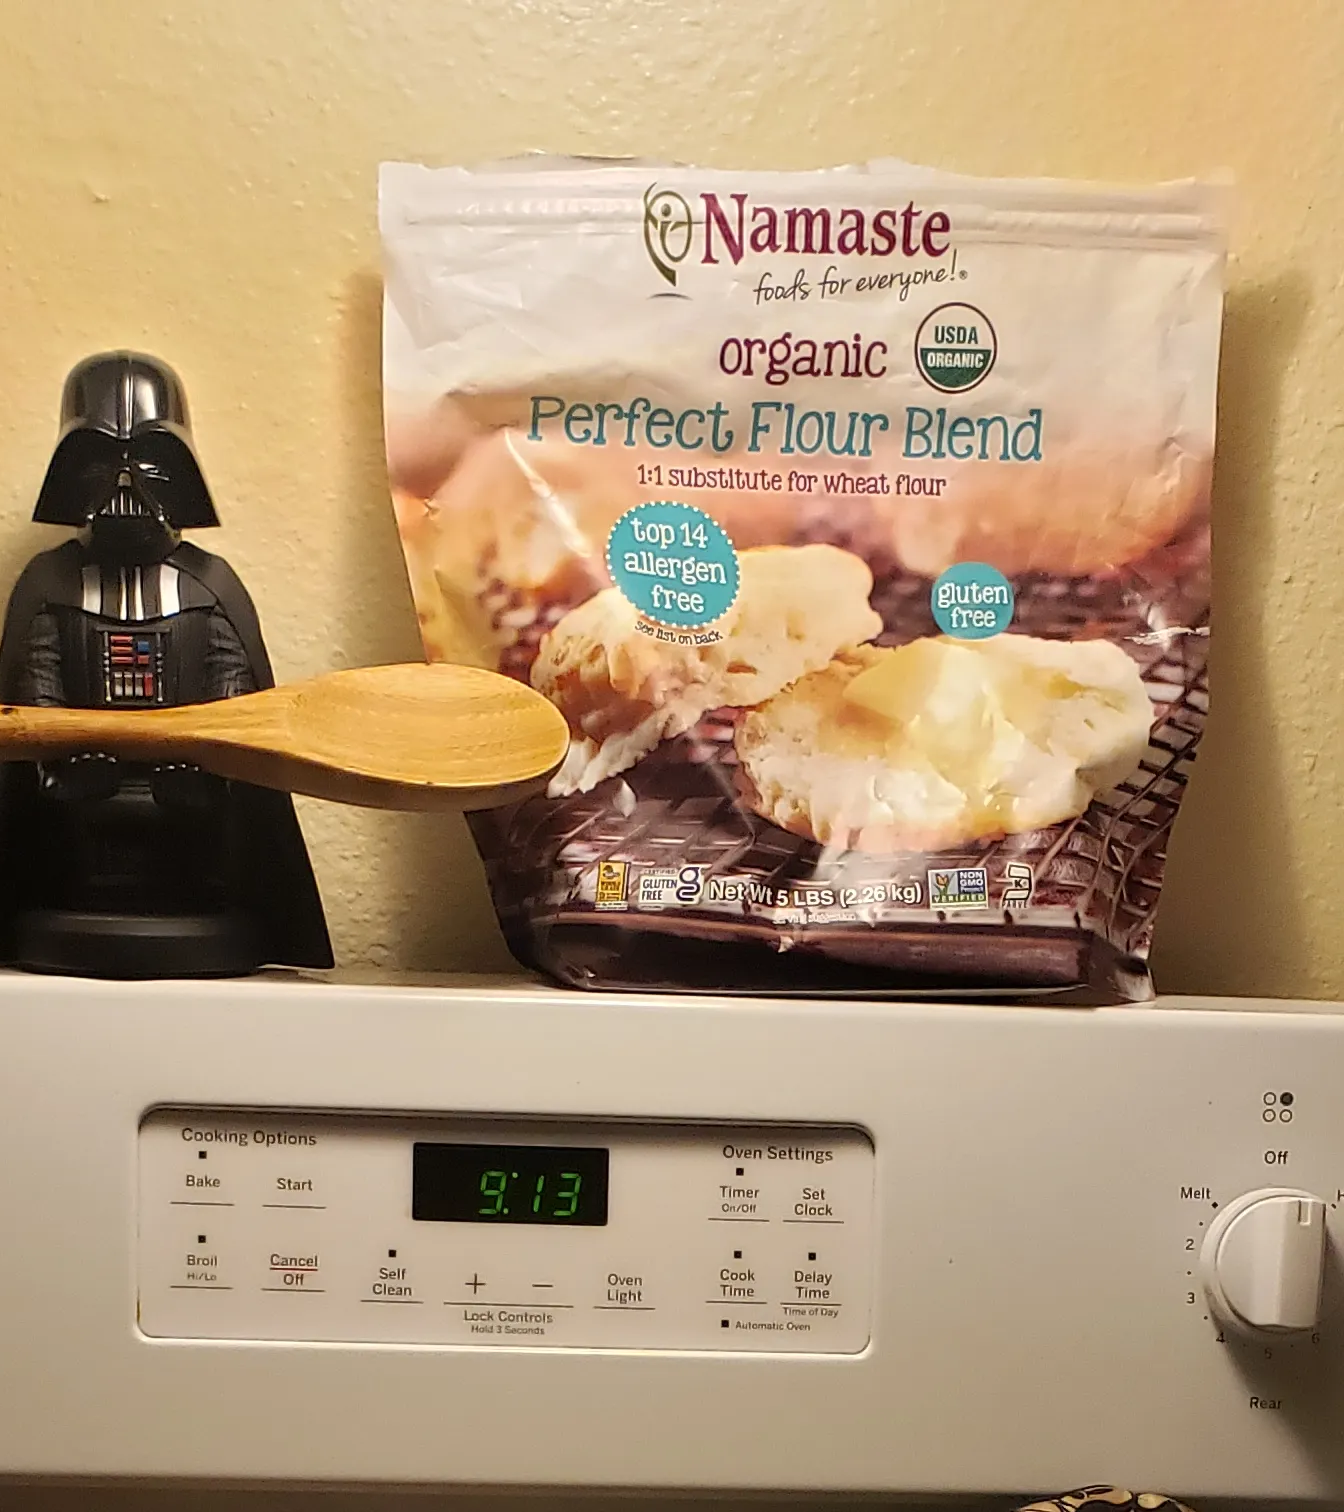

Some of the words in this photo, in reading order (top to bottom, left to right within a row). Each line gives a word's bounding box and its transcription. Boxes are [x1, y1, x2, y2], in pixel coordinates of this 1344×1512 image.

[699, 193, 951, 265] Namaste
[754, 269, 811, 305] foods
[817, 266, 852, 299] for
[934, 325, 979, 344] USDA
[719, 333, 888, 385] organic
[926, 352, 984, 368] ORGANIC
[527, 395, 734, 452] Perfect
[747, 401, 889, 456] Flour
[901, 406, 1044, 461] Blend
[637, 464, 664, 486] 1:1
[668, 466, 782, 493] substitute
[787, 469, 818, 493] for
[823, 471, 890, 495] wheat
[895, 472, 947, 497] flour
[630, 517, 675, 549] top
[679, 522, 708, 548] 14
[623, 551, 727, 585] allergen
[651, 584, 704, 613] free
[937, 582, 1009, 608] gluten
[950, 606, 997, 628] free
[634, 620, 655, 636] see
[656, 627, 676, 643] list
[678, 634, 692, 645] on
[695, 630, 723, 645] back
[642, 879, 677, 889] GLUTEN
[959, 879, 983, 887] GMO
[642, 890, 662, 900] FREE
[709, 881, 745, 901] Net
[749, 883, 773, 905] Wt
[776, 890, 788, 906] 5
[793, 890, 834, 906] LBS
[839, 885, 886, 908] (2.26
[891, 881, 922, 904] kg)
[933, 893, 985, 903] VERIFIED
[181, 1127, 248, 1146] Cooking
[253, 1129, 317, 1147] Options
[722, 1145, 762, 1160] Oven
[767, 1145, 833, 1164] Settings
[1264, 1150, 1288, 1165] Off
[185, 1174, 221, 1188] Bake
[276, 1177, 313, 1191] Start
[479, 1170, 582, 1216] 9:13
[719, 1185, 760, 1199] Timer
[802, 1187, 826, 1201] Set
[1180, 1187, 1211, 1200] Melt
[721, 1203, 757, 1213] On/Off
[794, 1203, 833, 1216] Clock
[1185, 1238, 1195, 1251] 2
[186, 1254, 218, 1267] Broil
[270, 1253, 318, 1267] Cancel
[186, 1272, 218, 1281] Hi/Lo
[283, 1274, 304, 1286] Off
[378, 1267, 406, 1281] Self
[607, 1273, 643, 1287] Oven
[719, 1268, 755, 1281] Cook
[794, 1270, 833, 1286] Delay
[372, 1283, 412, 1296] Clean
[719, 1284, 755, 1297] Time
[795, 1286, 830, 1299] Time
[606, 1289, 643, 1305] Light
[1186, 1292, 1195, 1305] 3
[463, 1309, 494, 1322] Lock
[498, 1310, 554, 1324] Controls
[783, 1307, 806, 1316] Time
[808, 1307, 819, 1316] of
[820, 1308, 839, 1318] Day
[471, 1324, 494, 1334] Hold
[496, 1325, 503, 1334] 3
[504, 1326, 545, 1335] Seconds
[735, 1320, 784, 1331] Automatic
[786, 1321, 811, 1331] Oven
[1216, 1332, 1226, 1344] 4
[1311, 1332, 1321, 1344] 6
[1249, 1396, 1283, 1410] Rear
